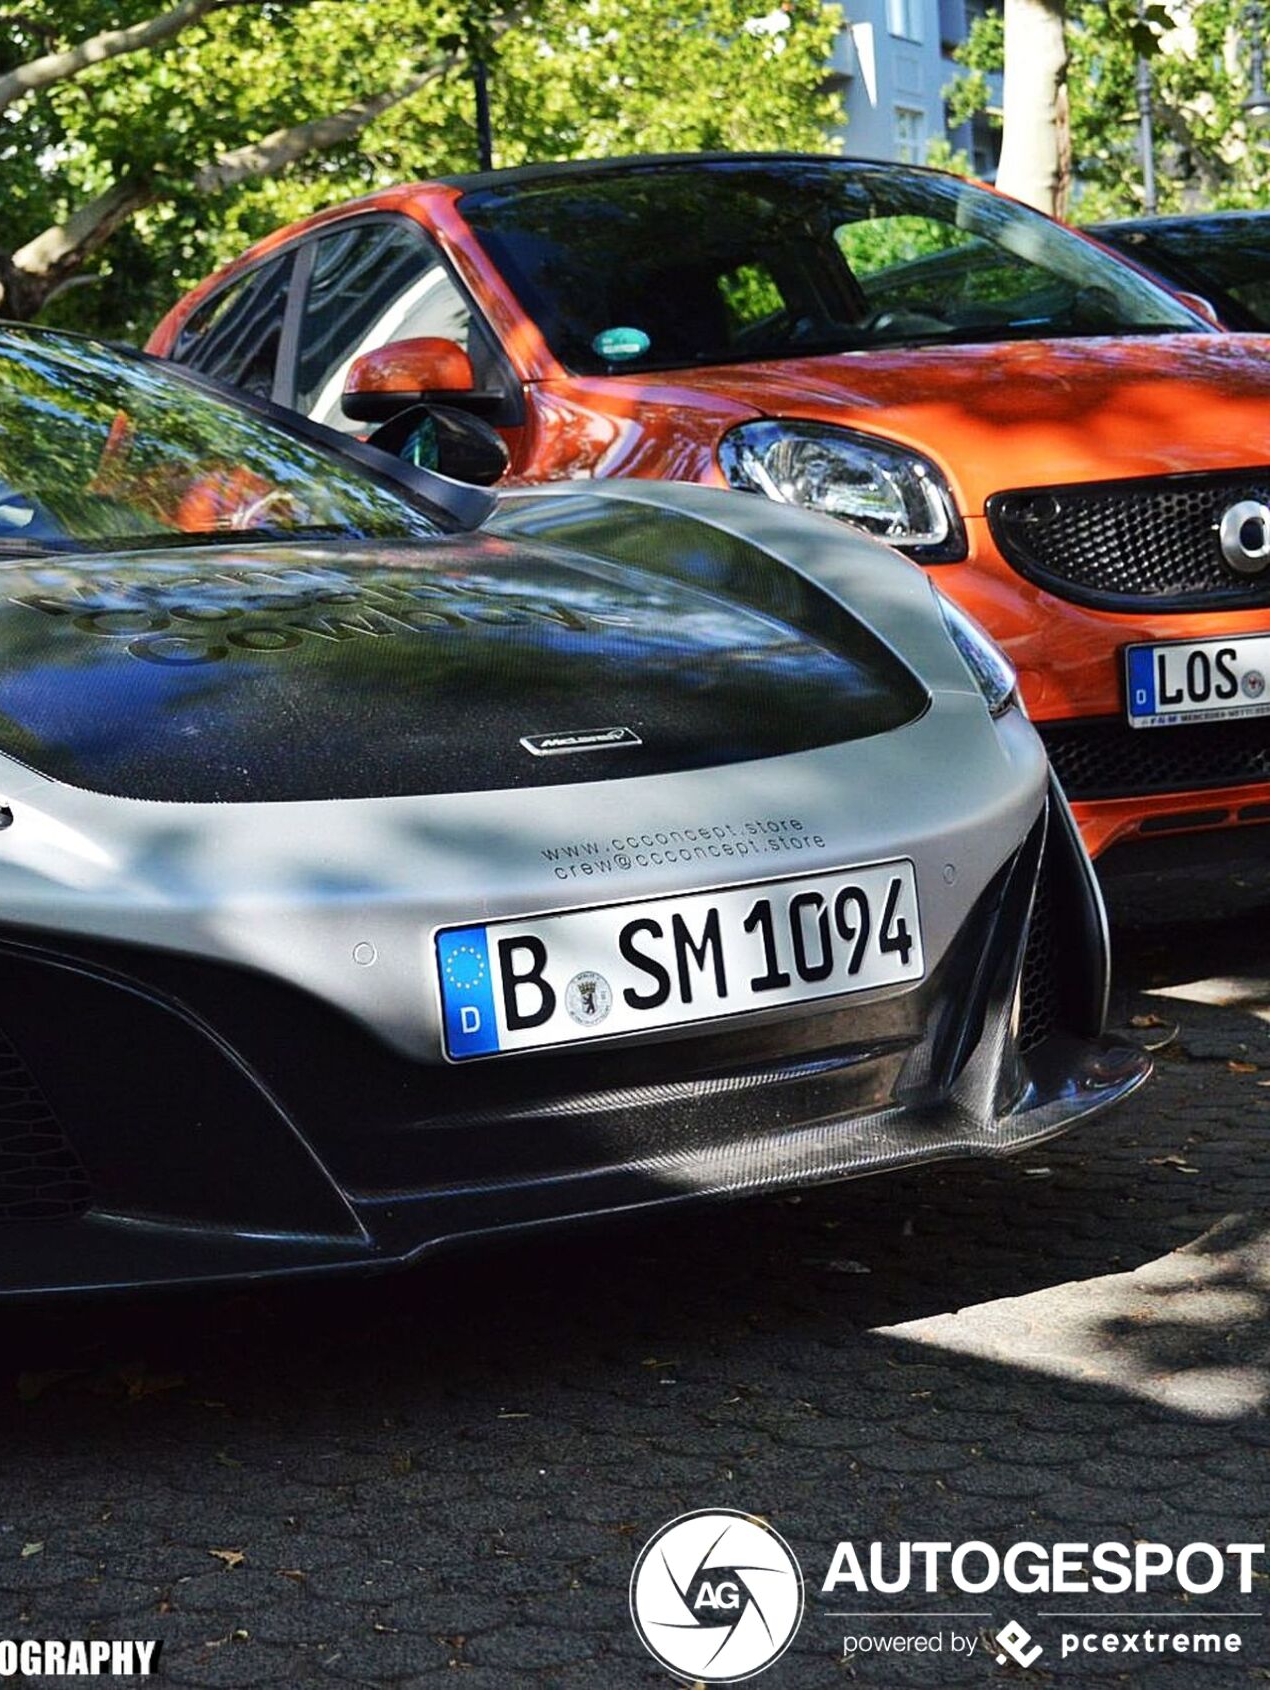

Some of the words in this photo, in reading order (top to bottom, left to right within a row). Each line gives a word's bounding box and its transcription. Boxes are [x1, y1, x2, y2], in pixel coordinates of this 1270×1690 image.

[126, 598, 637, 667] Cowboys
[1158, 648, 1238, 705] LOS
[541, 817, 804, 862] www.ccconcept.store
[554, 833, 826, 880] crew@ccconcept.store
[497, 935, 556, 1031] B
[619, 908, 728, 1010] SM
[743, 878, 912, 992] 1094
[460, 1006, 480, 1034] D
